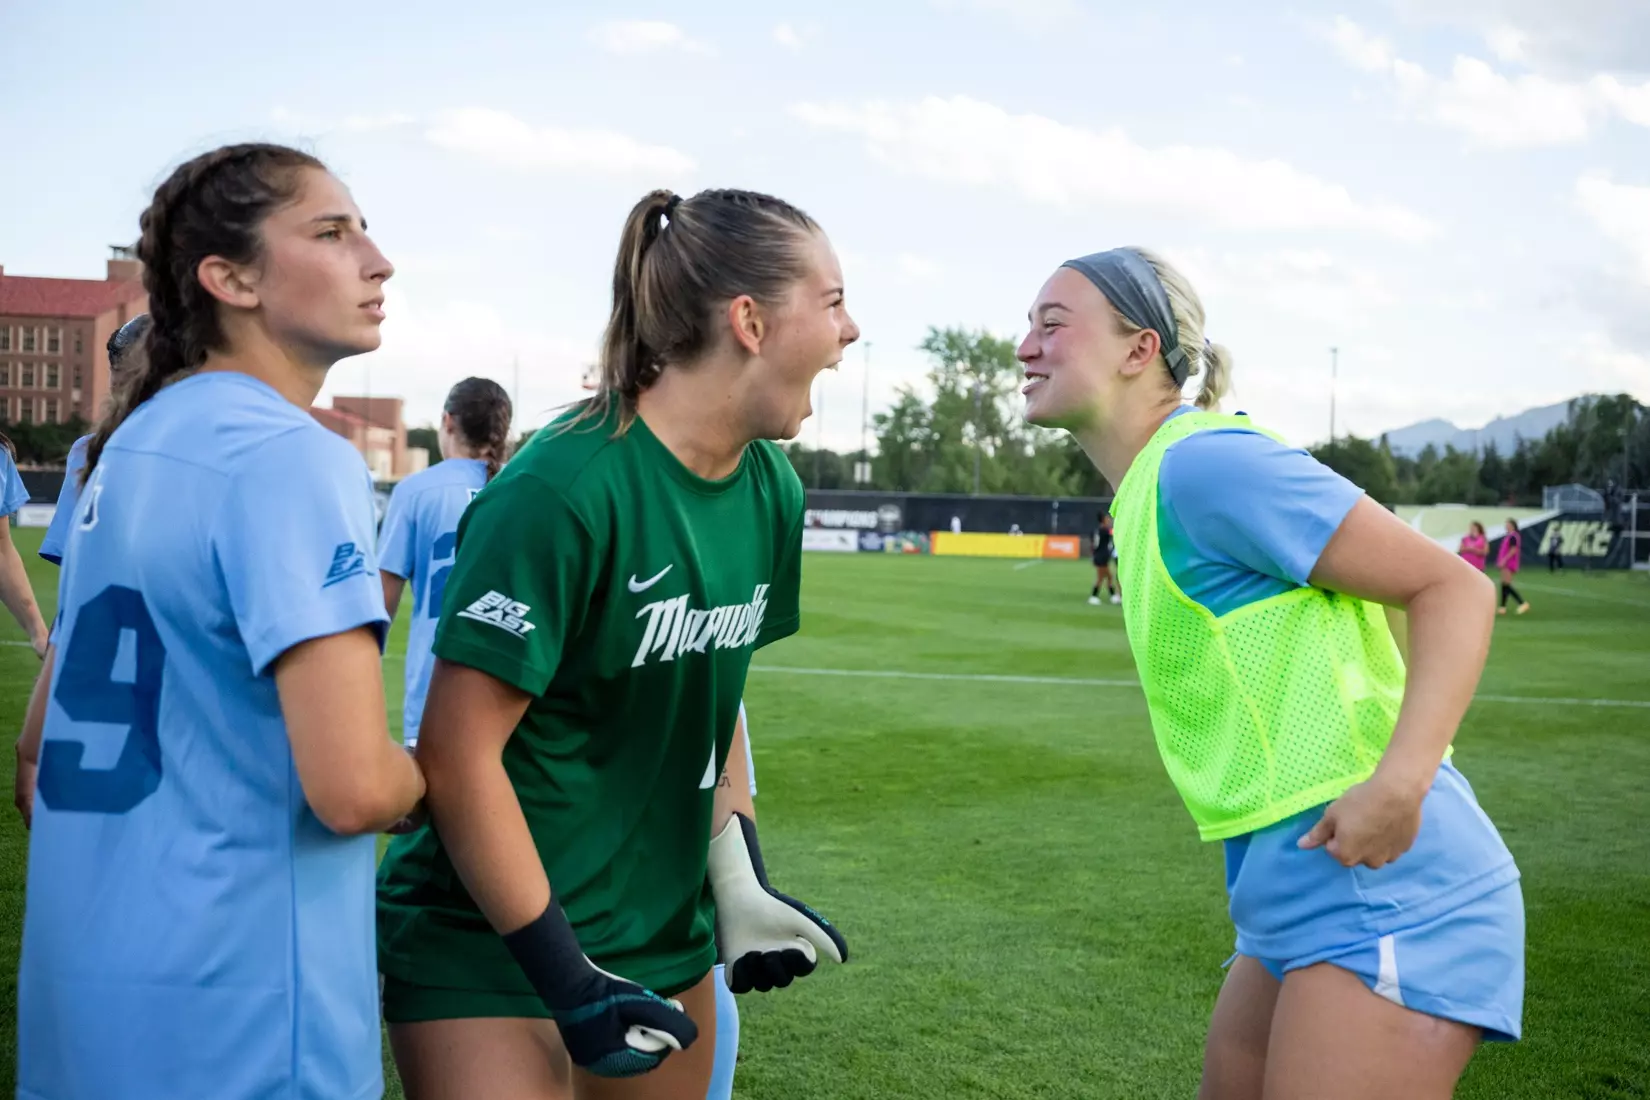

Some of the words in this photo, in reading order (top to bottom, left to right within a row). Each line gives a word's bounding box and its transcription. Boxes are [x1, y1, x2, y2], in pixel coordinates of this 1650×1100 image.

[465, 600, 536, 634] EAST
[479, 589, 531, 618] BIG
[37, 584, 166, 815] 9
